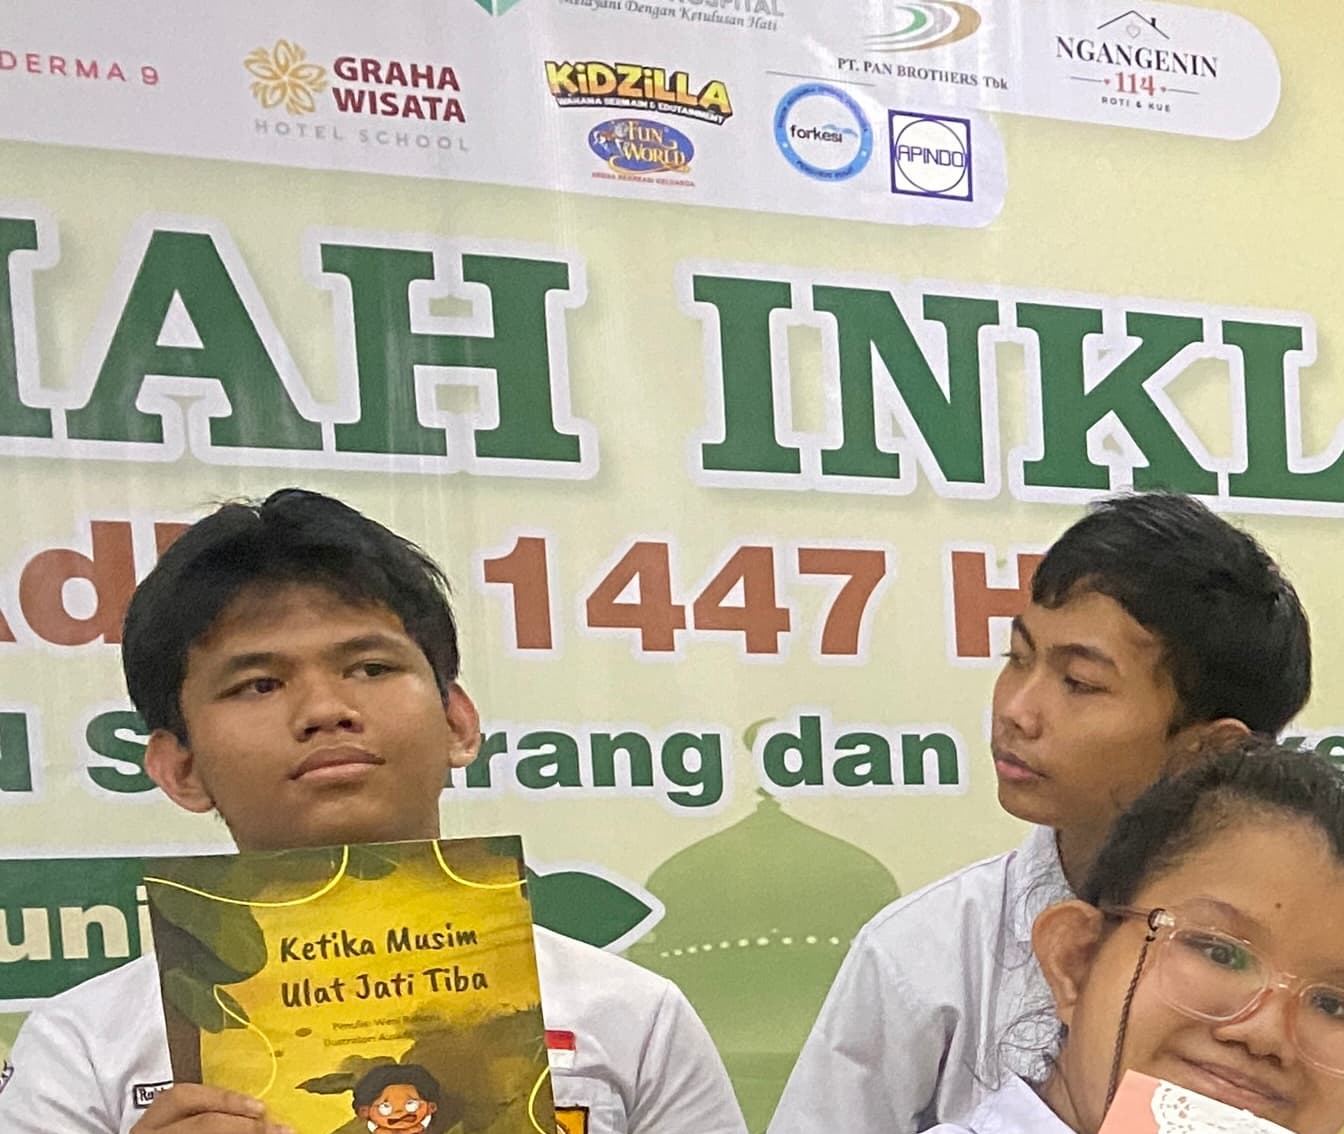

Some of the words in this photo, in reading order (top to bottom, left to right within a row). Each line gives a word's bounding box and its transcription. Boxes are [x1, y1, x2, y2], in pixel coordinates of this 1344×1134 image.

[0, 50, 126, 82] DERMA
[141, 66, 159, 85] 9
[333, 56, 461, 91] GRAHA
[838, 57, 859, 72] PT.
[864, 61, 892, 75] PAN
[897, 64, 978, 86] BROTHERS
[983, 76, 1009, 90] Tbk
[1056, 35, 1218, 78] NGANGENIN
[1115, 71, 1156, 96] 114
[332, 87, 466, 123] WISATA
[1101, 96, 1130, 108] ROTI
[1148, 102, 1171, 113] KUE
[255, 119, 343, 141] HOTEL
[359, 129, 470, 151] SCHOOL
[790, 125, 842, 143] forkesi
[897, 144, 965, 168] APINDO
[484, 536, 886, 655] 1447
[951, 551, 1048, 657] H
[763, 715, 959, 787] dan
[281, 929, 377, 963] Ketika
[387, 923, 479, 954] Musim
[281, 979, 345, 1009] Ulat
[356, 973, 414, 1000] Jati
[423, 966, 489, 994] Tiba
